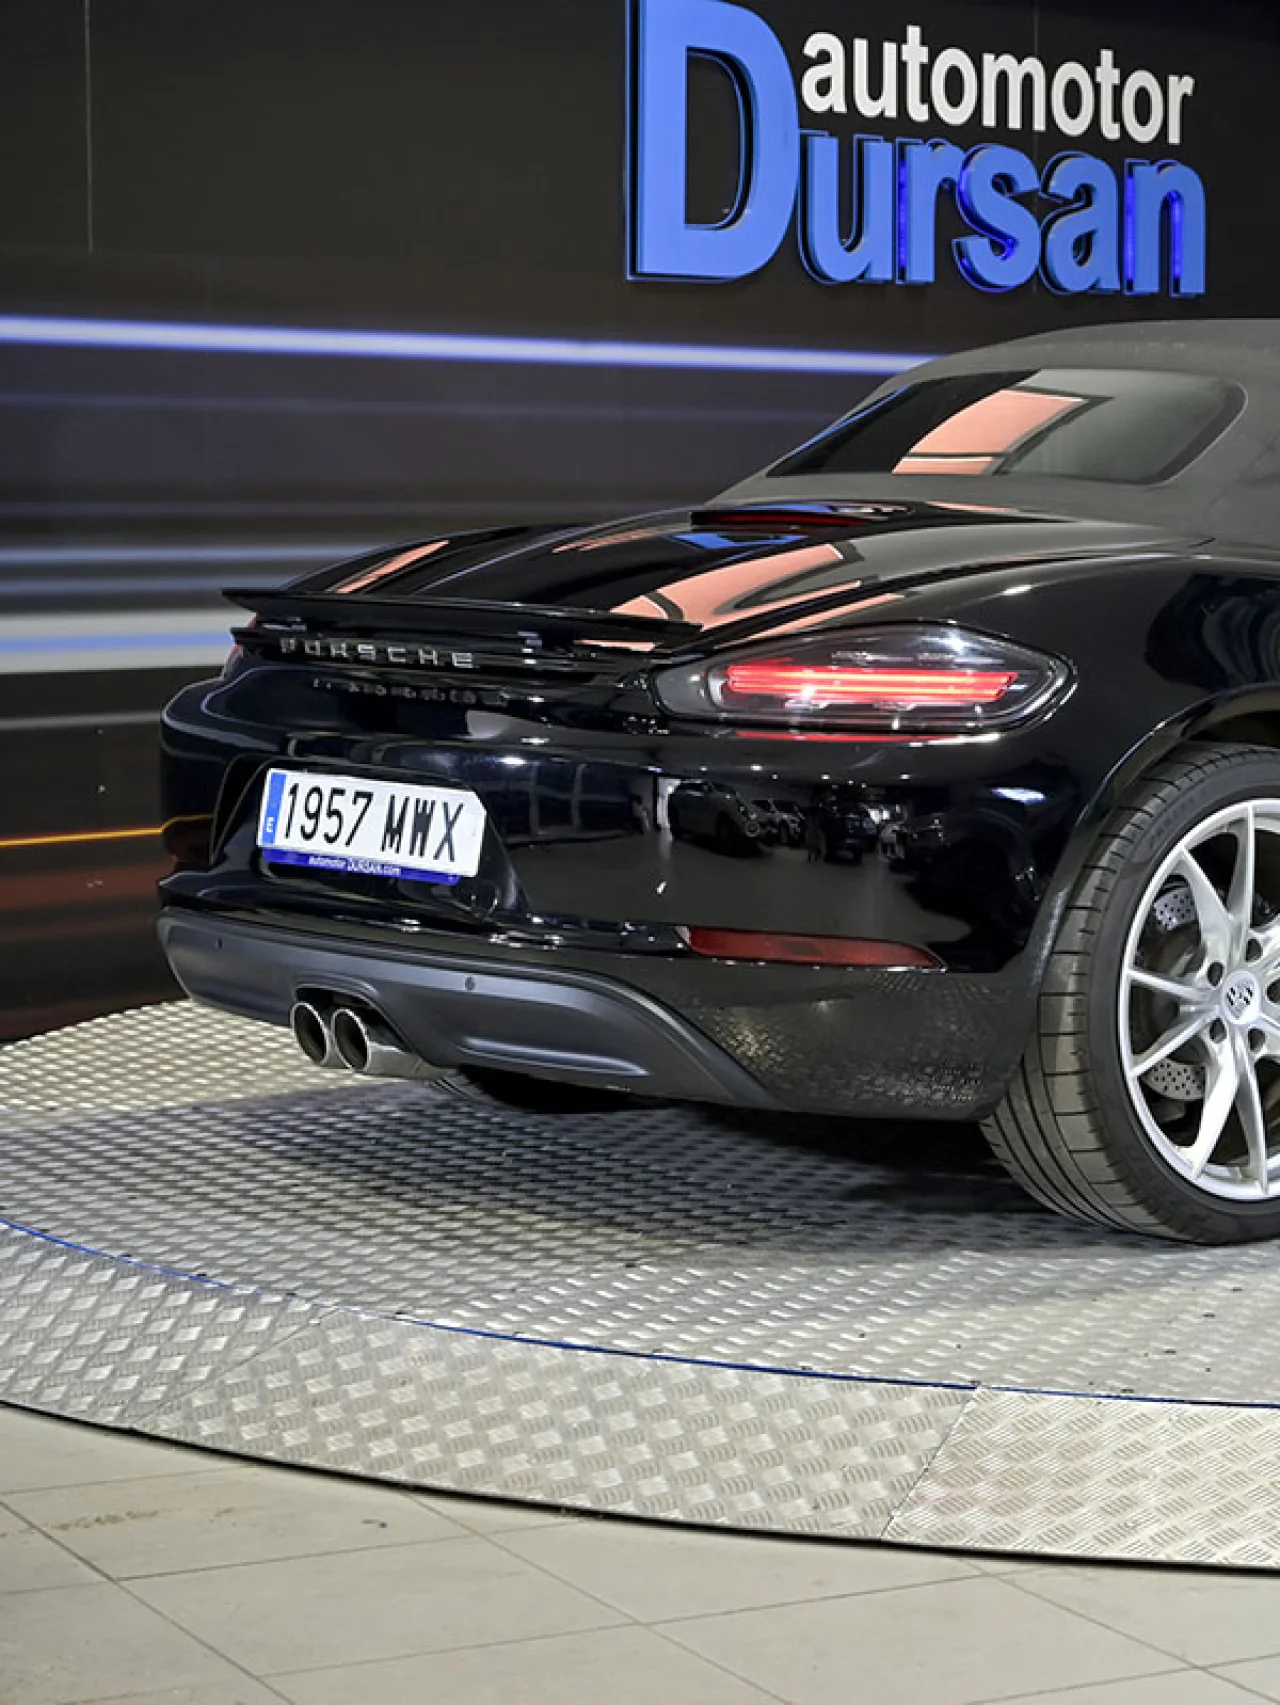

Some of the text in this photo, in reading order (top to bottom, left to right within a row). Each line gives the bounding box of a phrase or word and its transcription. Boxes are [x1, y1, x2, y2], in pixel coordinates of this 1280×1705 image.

[801, 25, 1195, 145] automotor
[626, 0, 1206, 296] Dursan
[284, 782, 464, 862] 1957 MWX
